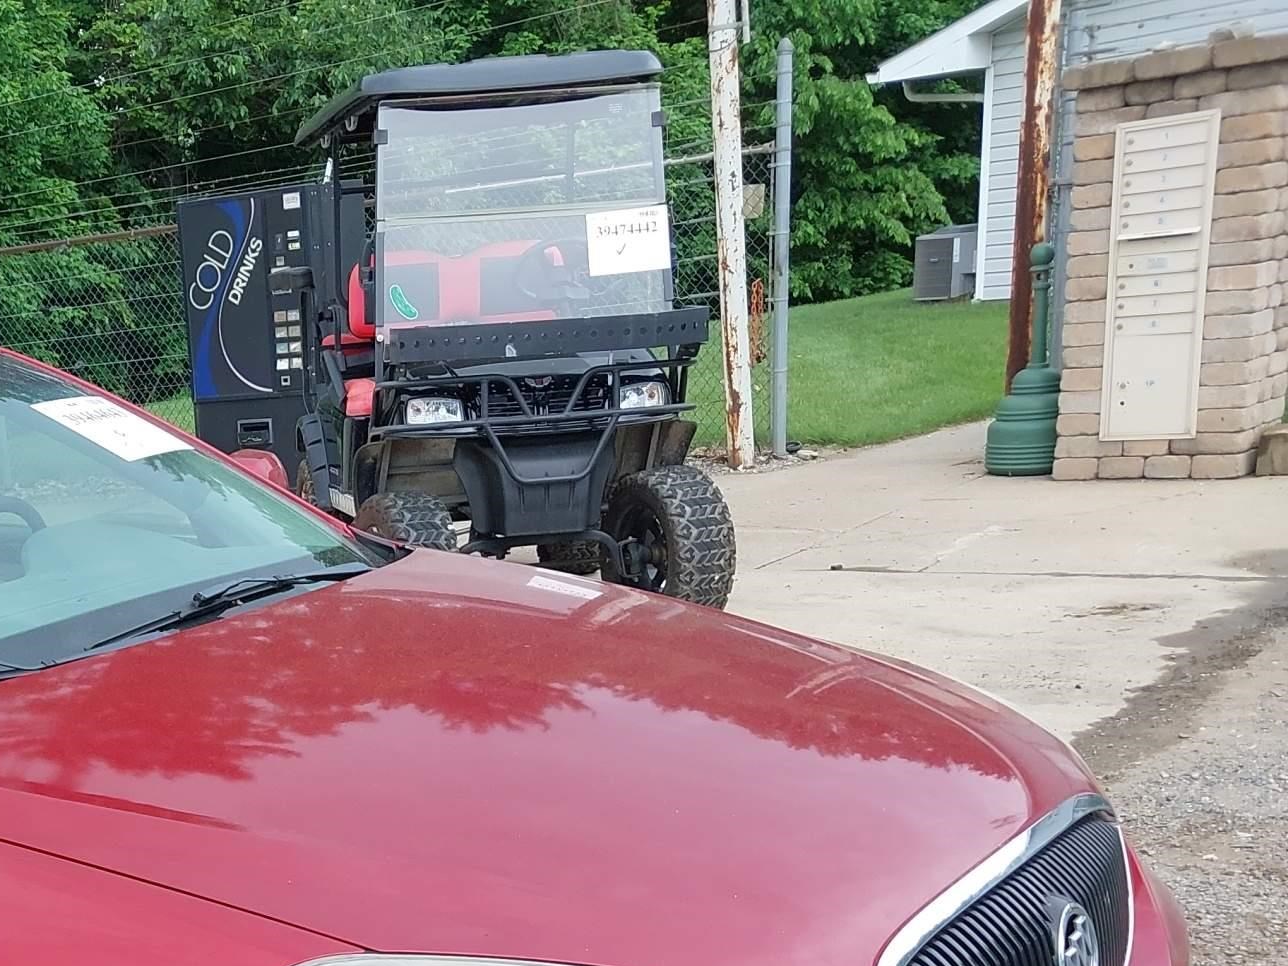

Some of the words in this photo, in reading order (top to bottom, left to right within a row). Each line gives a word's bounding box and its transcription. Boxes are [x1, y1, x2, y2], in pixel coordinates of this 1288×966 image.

[598, 221, 657, 236] 39474442
[189, 230, 233, 310] COLD
[228, 237, 263, 305] DRINKS
